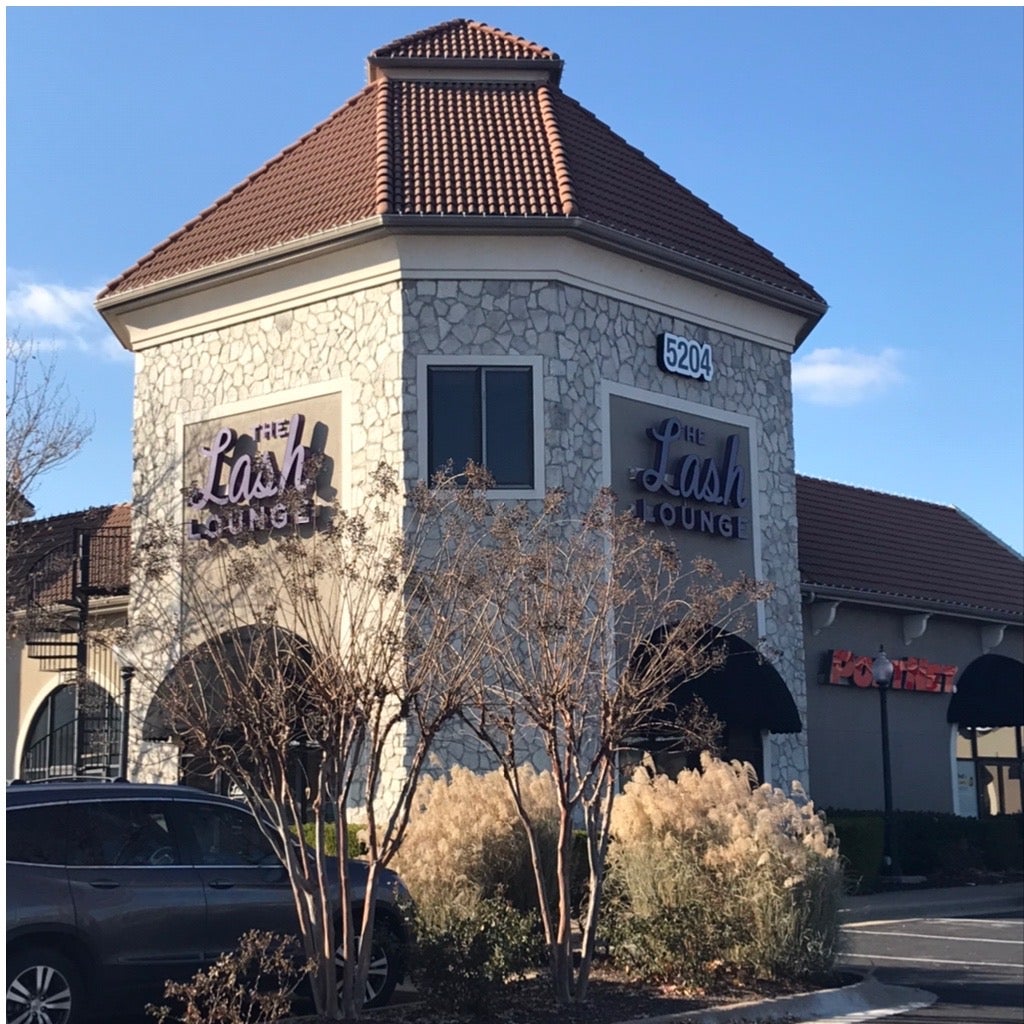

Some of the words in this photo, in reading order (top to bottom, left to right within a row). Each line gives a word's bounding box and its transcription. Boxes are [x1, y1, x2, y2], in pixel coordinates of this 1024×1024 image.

[665, 337, 712, 378] 5204
[252, 419, 290, 442] THE
[679, 425, 706, 447] HE
[187, 413, 308, 510] Lash
[642, 416, 748, 509] Lash
[639, 498, 749, 539] LOUNGE
[828, 649, 958, 693] POTNET
